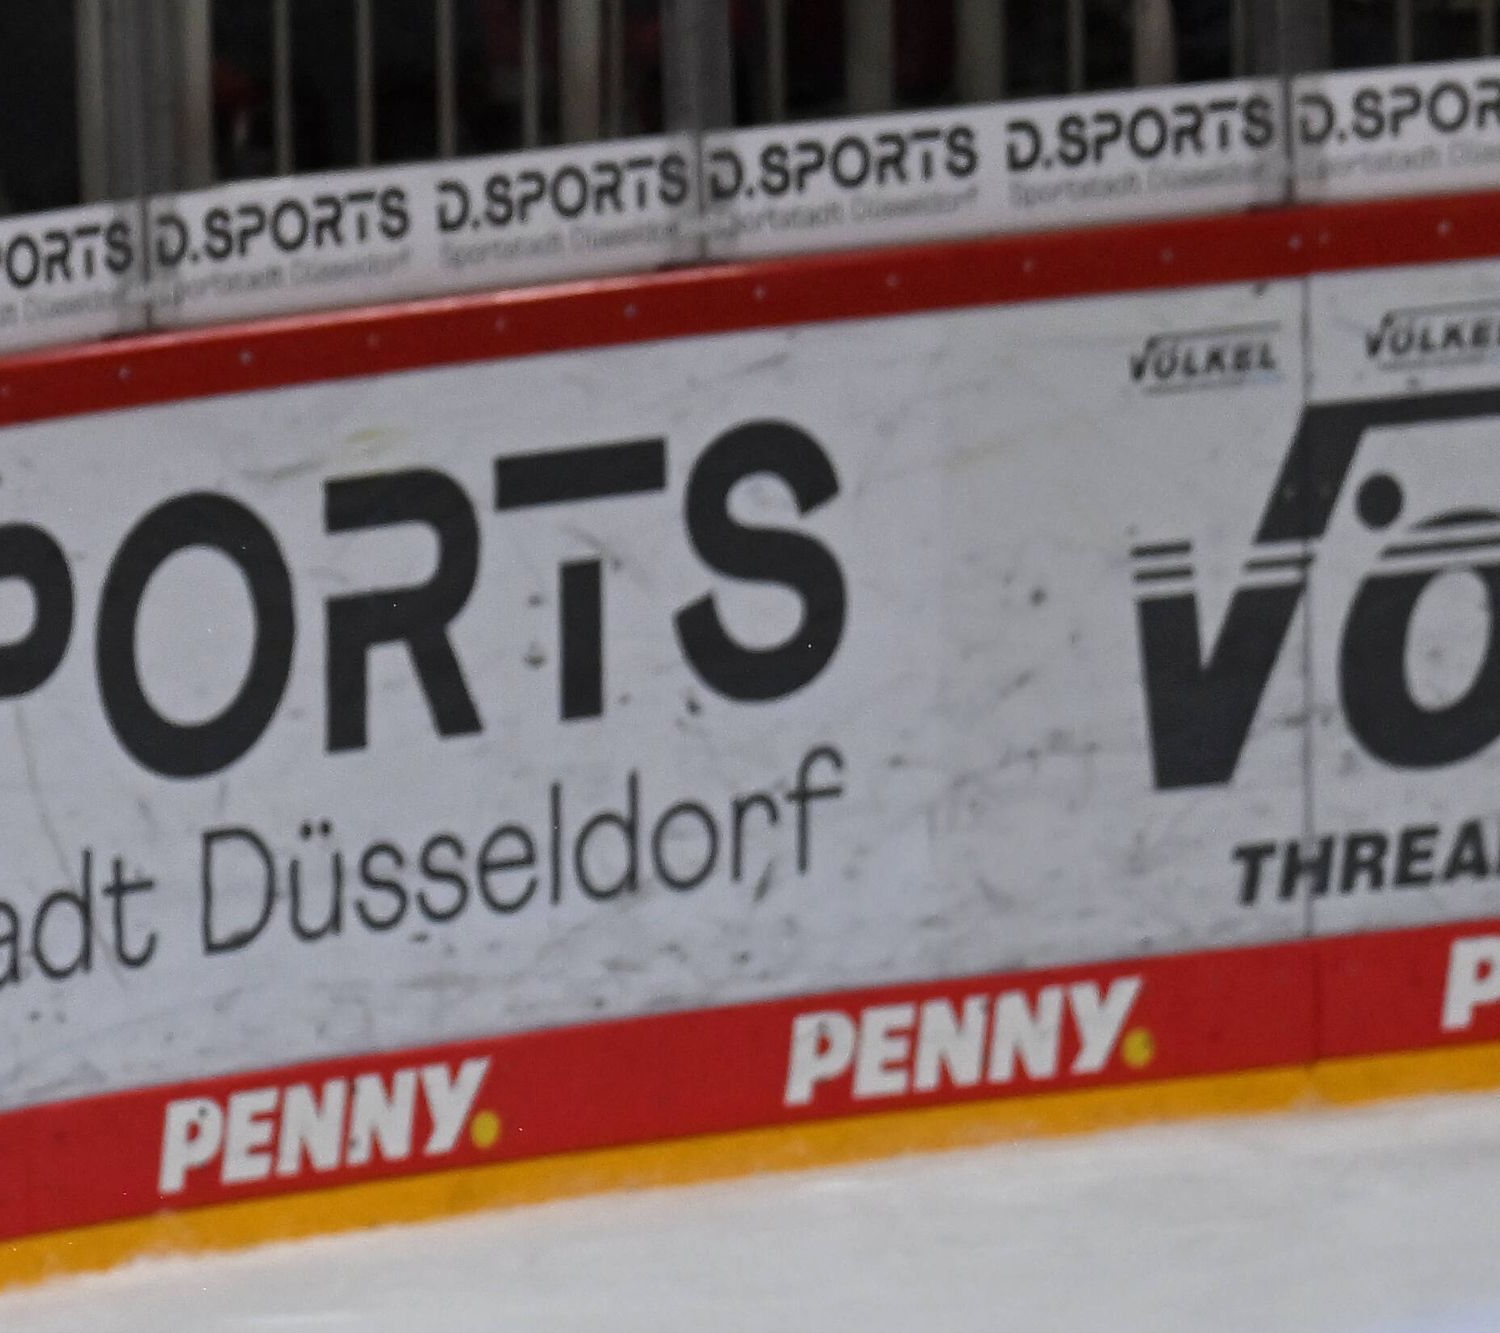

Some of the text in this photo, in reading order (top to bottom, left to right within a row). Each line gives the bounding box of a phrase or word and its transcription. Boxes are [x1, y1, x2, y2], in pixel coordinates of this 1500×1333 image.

[708, 93, 1273, 201] D.SPORTS D.SPORTS
[156, 152, 689, 267] D.SPORTS D.SPORTS
[200, 746, 845, 956] Düsseldorf
